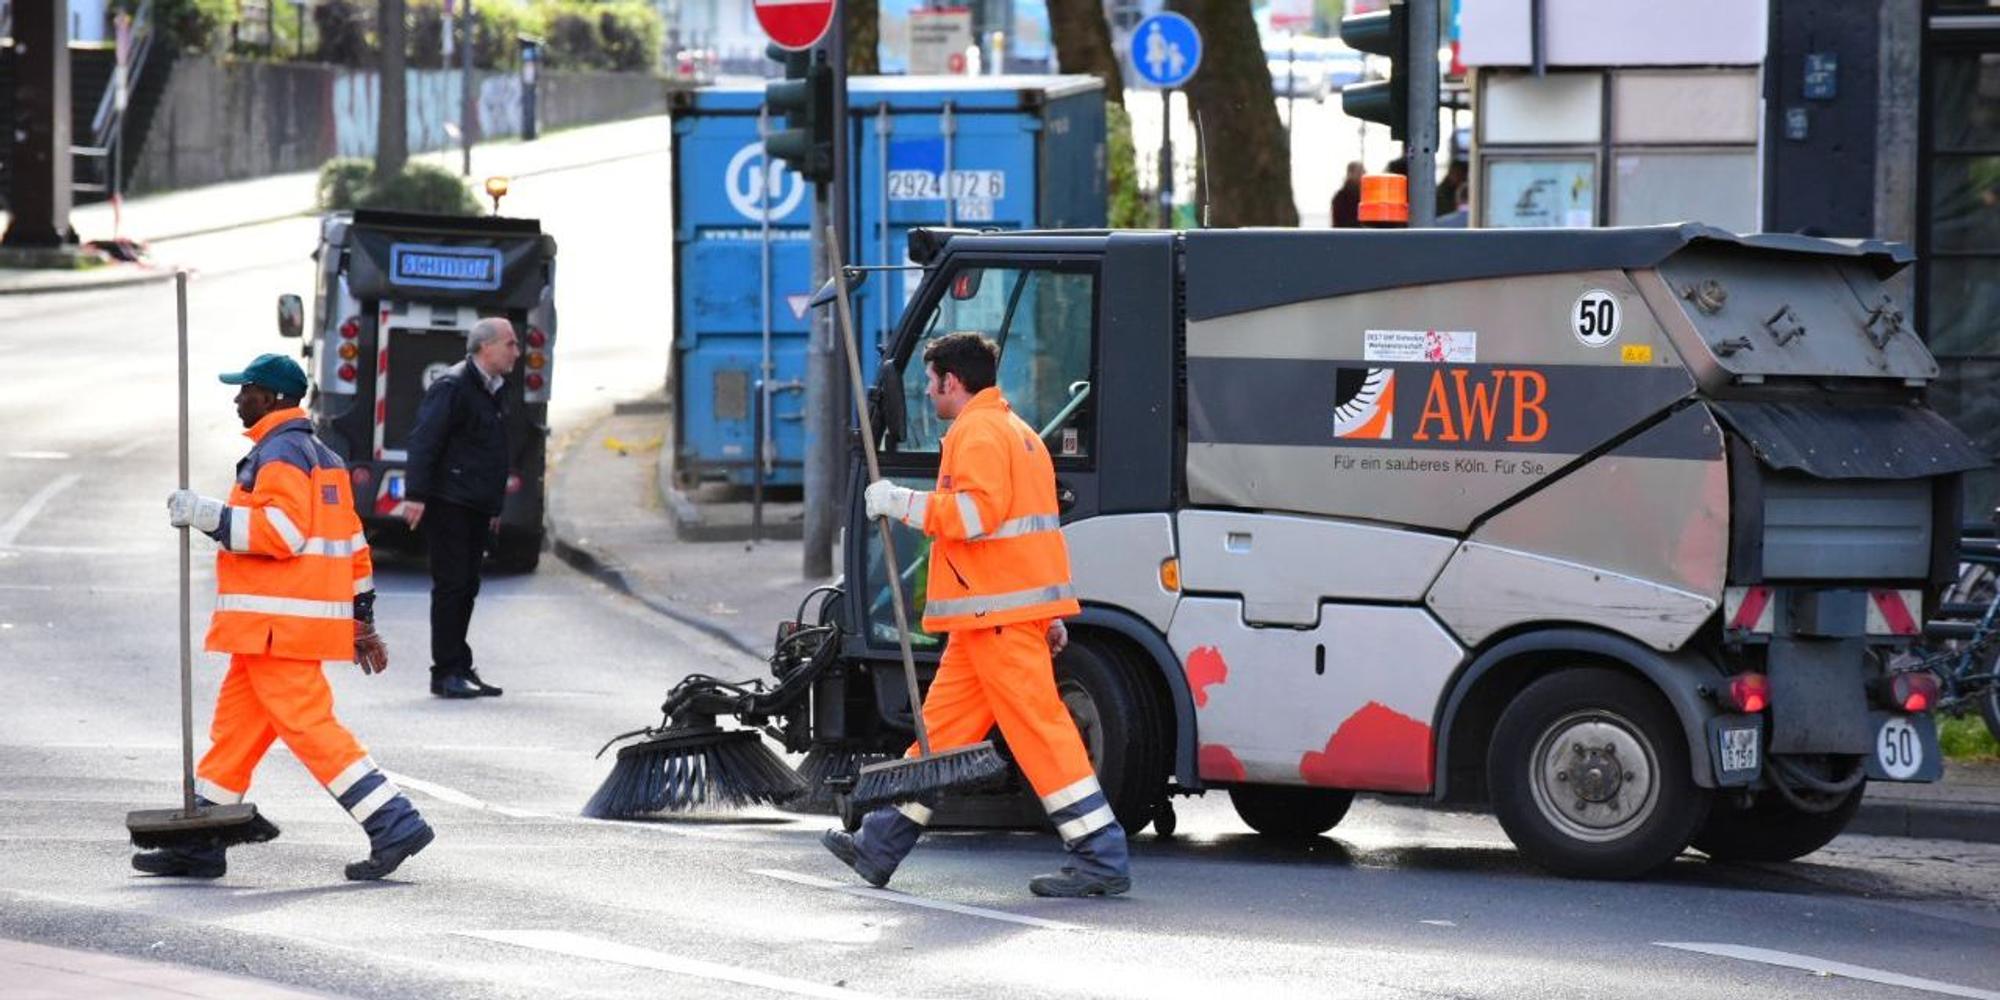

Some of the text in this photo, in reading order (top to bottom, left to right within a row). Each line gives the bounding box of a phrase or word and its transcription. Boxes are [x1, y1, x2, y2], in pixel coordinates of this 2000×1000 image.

[402, 253, 490, 279] SCHMIDT
[1580, 299, 1614, 336] 50
[1412, 369, 1549, 442] AWB
[1334, 454, 1355, 470] Für
[1360, 458, 1380, 470] ein
[1385, 456, 1450, 472] sauberes
[1454, 458, 1488, 473] Köln.
[1521, 460, 1547, 475] Sie.
[1886, 727, 1913, 767] 50
